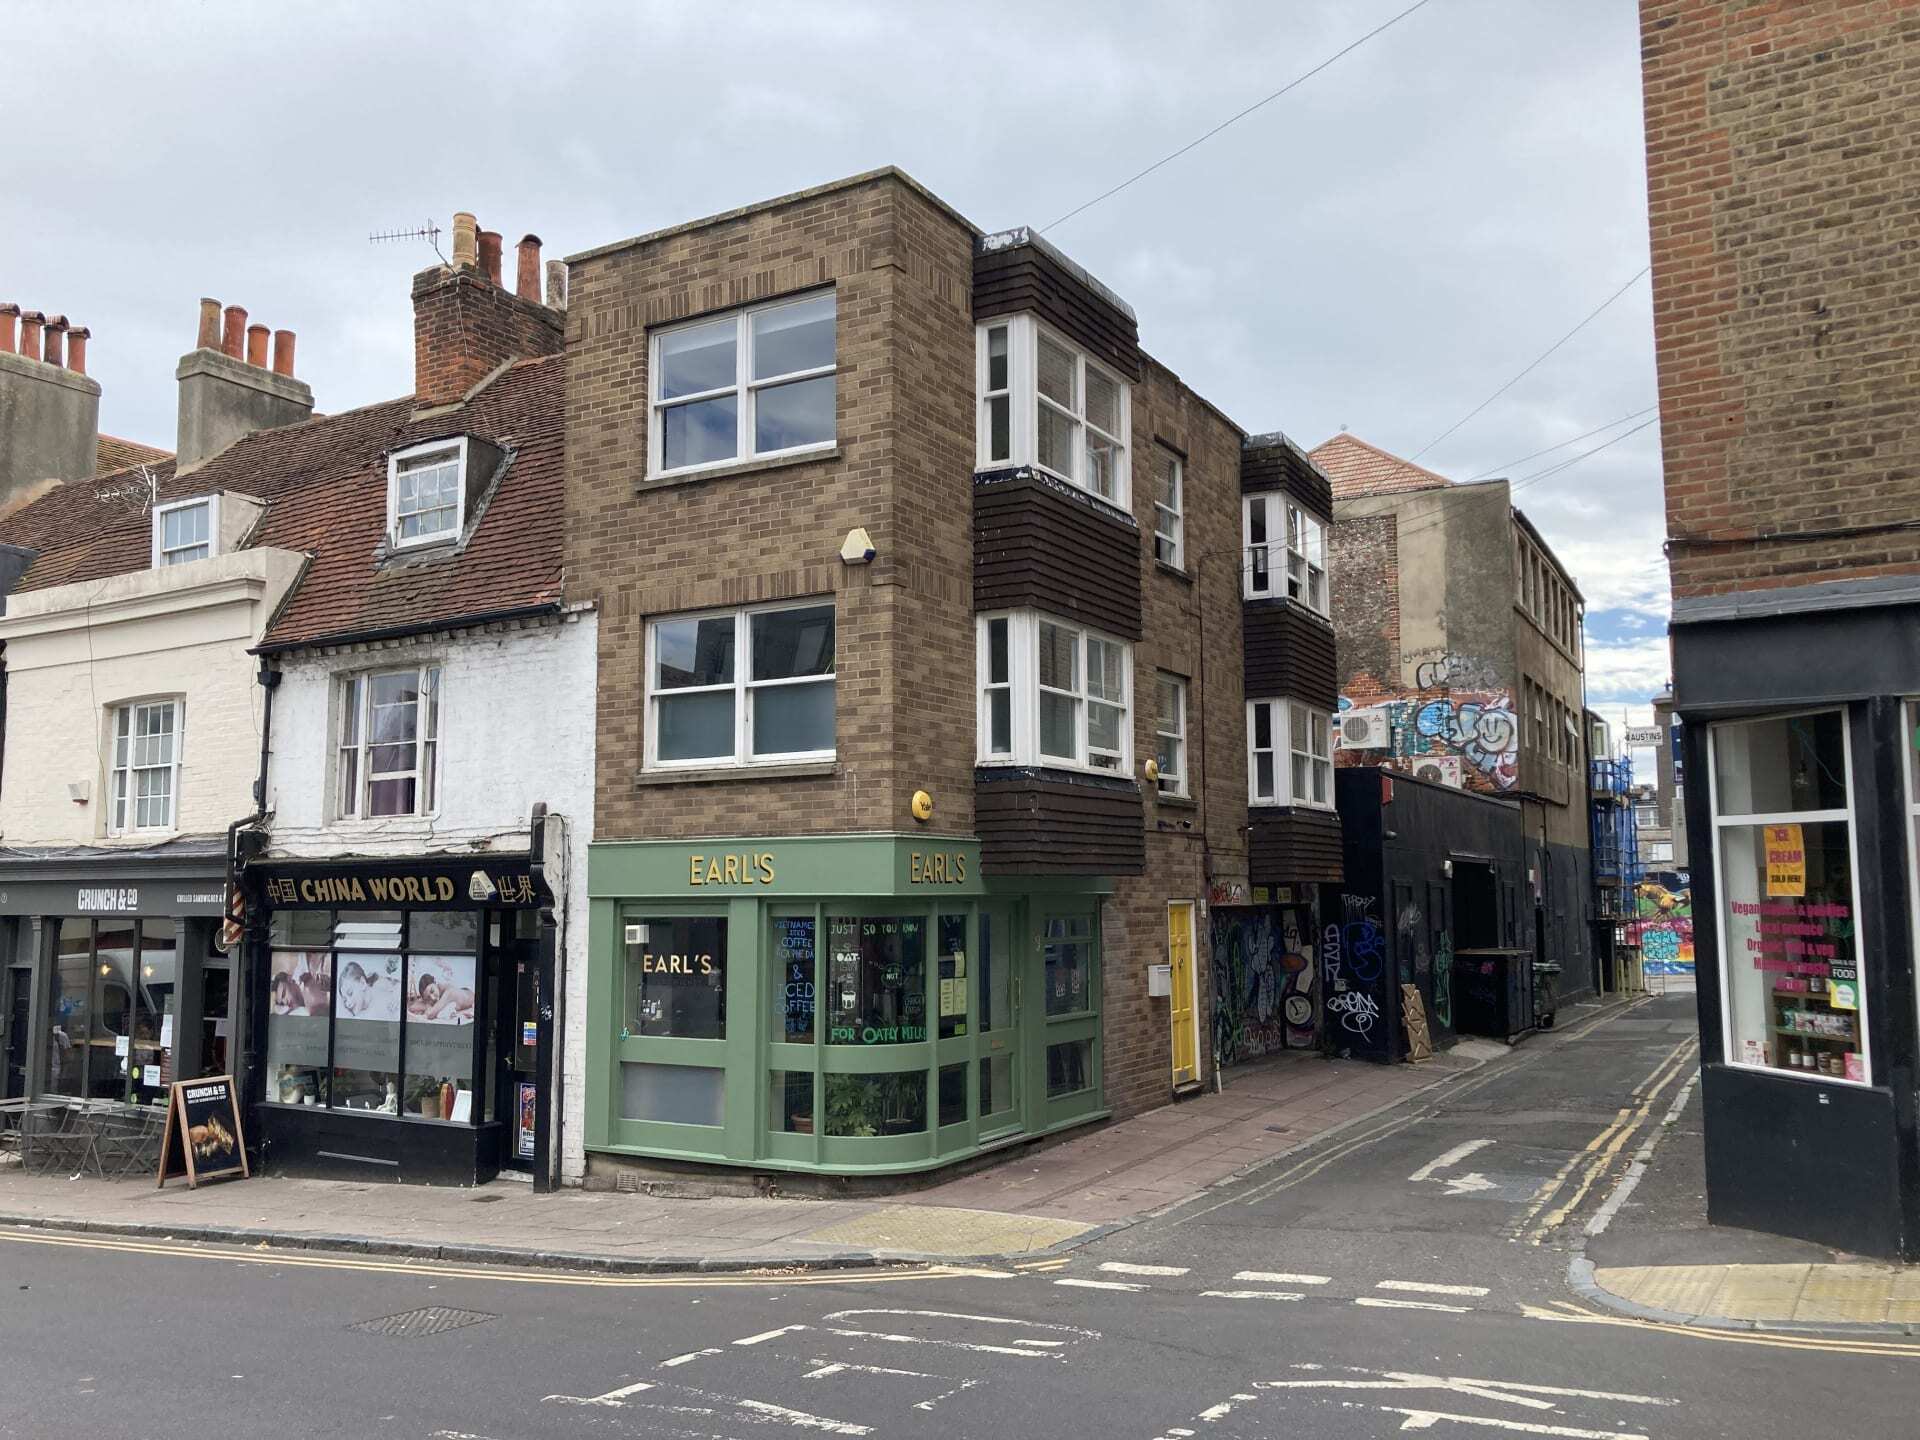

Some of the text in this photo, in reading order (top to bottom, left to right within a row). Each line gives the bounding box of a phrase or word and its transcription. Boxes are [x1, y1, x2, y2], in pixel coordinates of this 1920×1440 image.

[690, 852, 775, 886] EARL'S
[910, 852, 967, 884] EARL'S
[301, 877, 366, 902] CHINA
[368, 876, 454, 901] WORLD
[78, 888, 138, 910] CRUNCH & CO
[1730, 901, 1760, 915] Vegan
[830, 924, 856, 934] JUST
[863, 923, 876, 935] SO
[882, 923, 897, 934] YOU
[781, 937, 813, 948] COFFEE
[643, 954, 712, 975] EARL'S
[792, 963, 803, 980] &
[1832, 968, 1856, 979] FOOD
[776, 982, 815, 999] ICED
[774, 1000, 816, 1014] COFFEE
[831, 1028, 855, 1041] FOR
[862, 1026, 899, 1044] OATLY
[186, 1086, 213, 1099] CRUNCH
